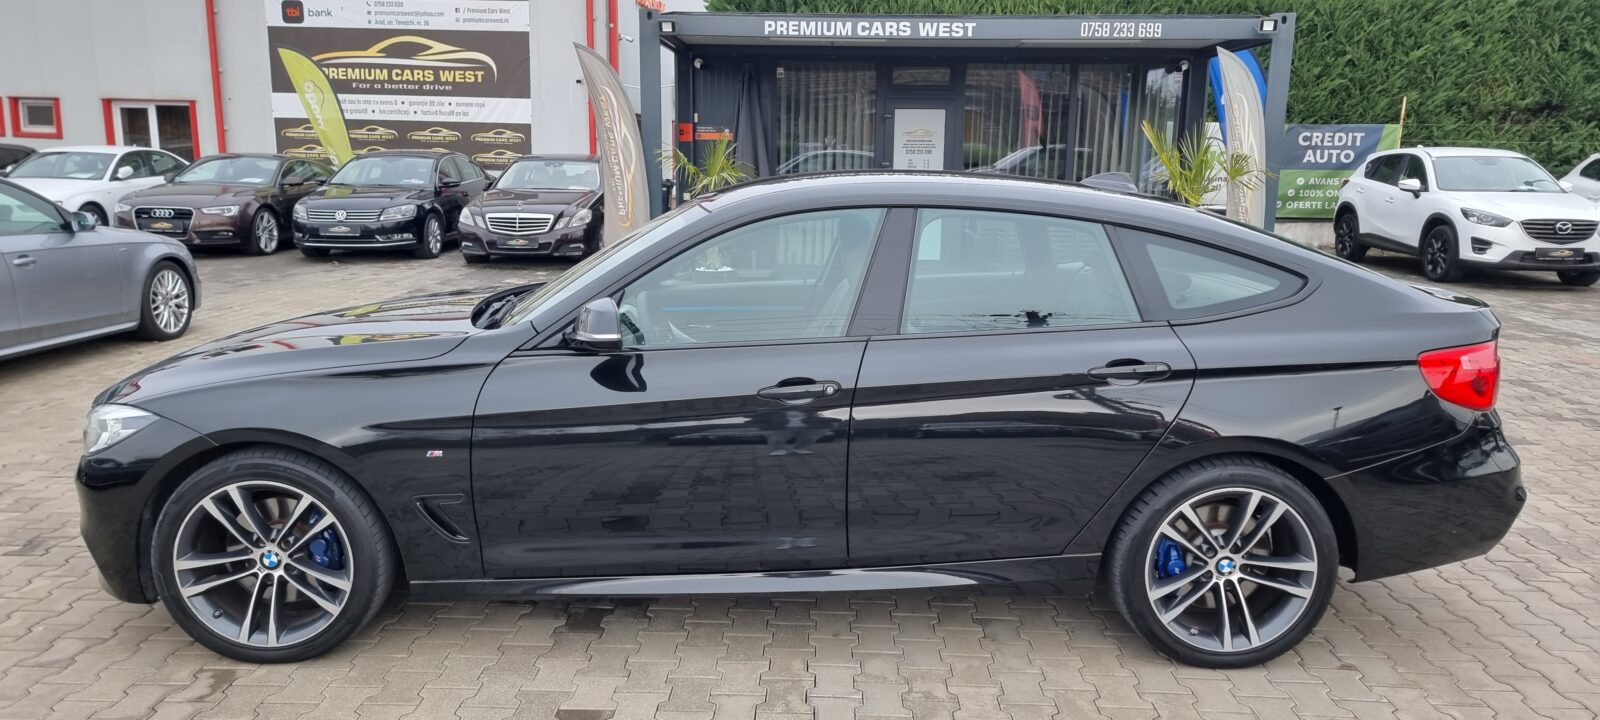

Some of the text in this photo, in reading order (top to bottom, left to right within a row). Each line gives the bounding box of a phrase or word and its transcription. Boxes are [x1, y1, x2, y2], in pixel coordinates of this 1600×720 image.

[286, 7, 333, 17] tbi bank
[764, 21, 976, 37] PREMIUM CARS WEST
[1081, 22, 1162, 38] 0758 233 699
[392, 69, 434, 81] CARS
[440, 71, 484, 82] WEST
[1298, 132, 1365, 147] CREDIT
[1302, 149, 1355, 163] AUTO
